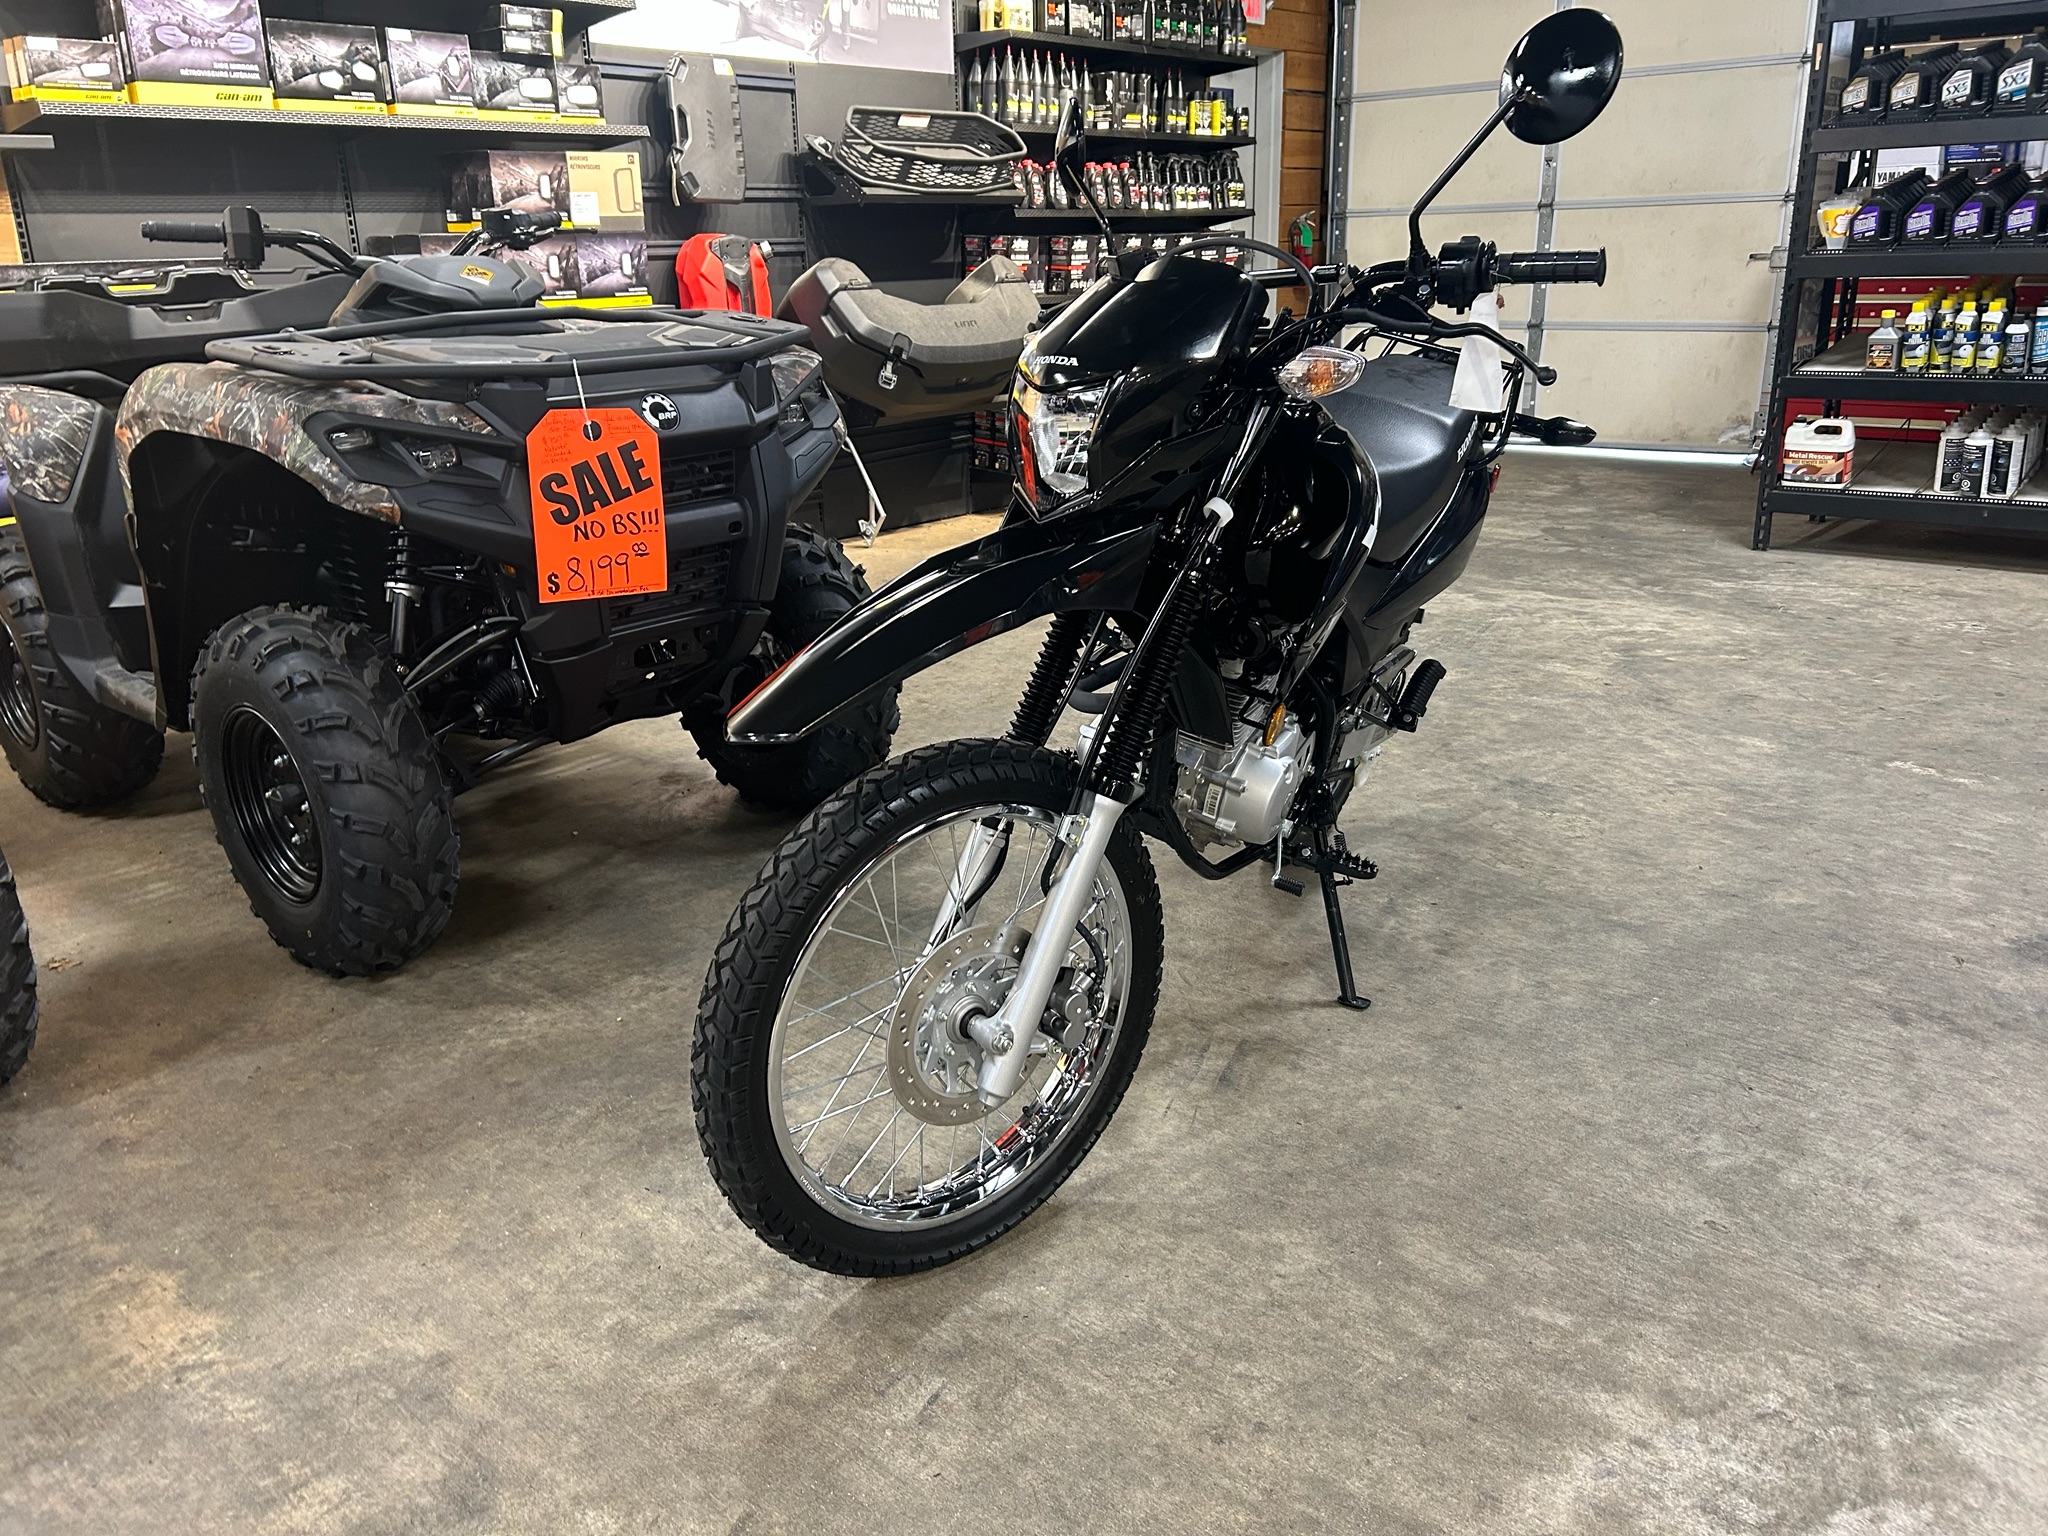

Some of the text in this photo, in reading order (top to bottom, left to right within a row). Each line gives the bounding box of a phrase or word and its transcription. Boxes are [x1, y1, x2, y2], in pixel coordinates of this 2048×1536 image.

[215, 92, 263, 102] can-am
[1032, 355, 1079, 366] HONDA
[658, 411, 677, 420] BRP
[1788, 451, 1808, 459] Metal
[539, 439, 654, 526] SALE
[573, 520, 606, 542] NO
[547, 572, 560, 596] $
